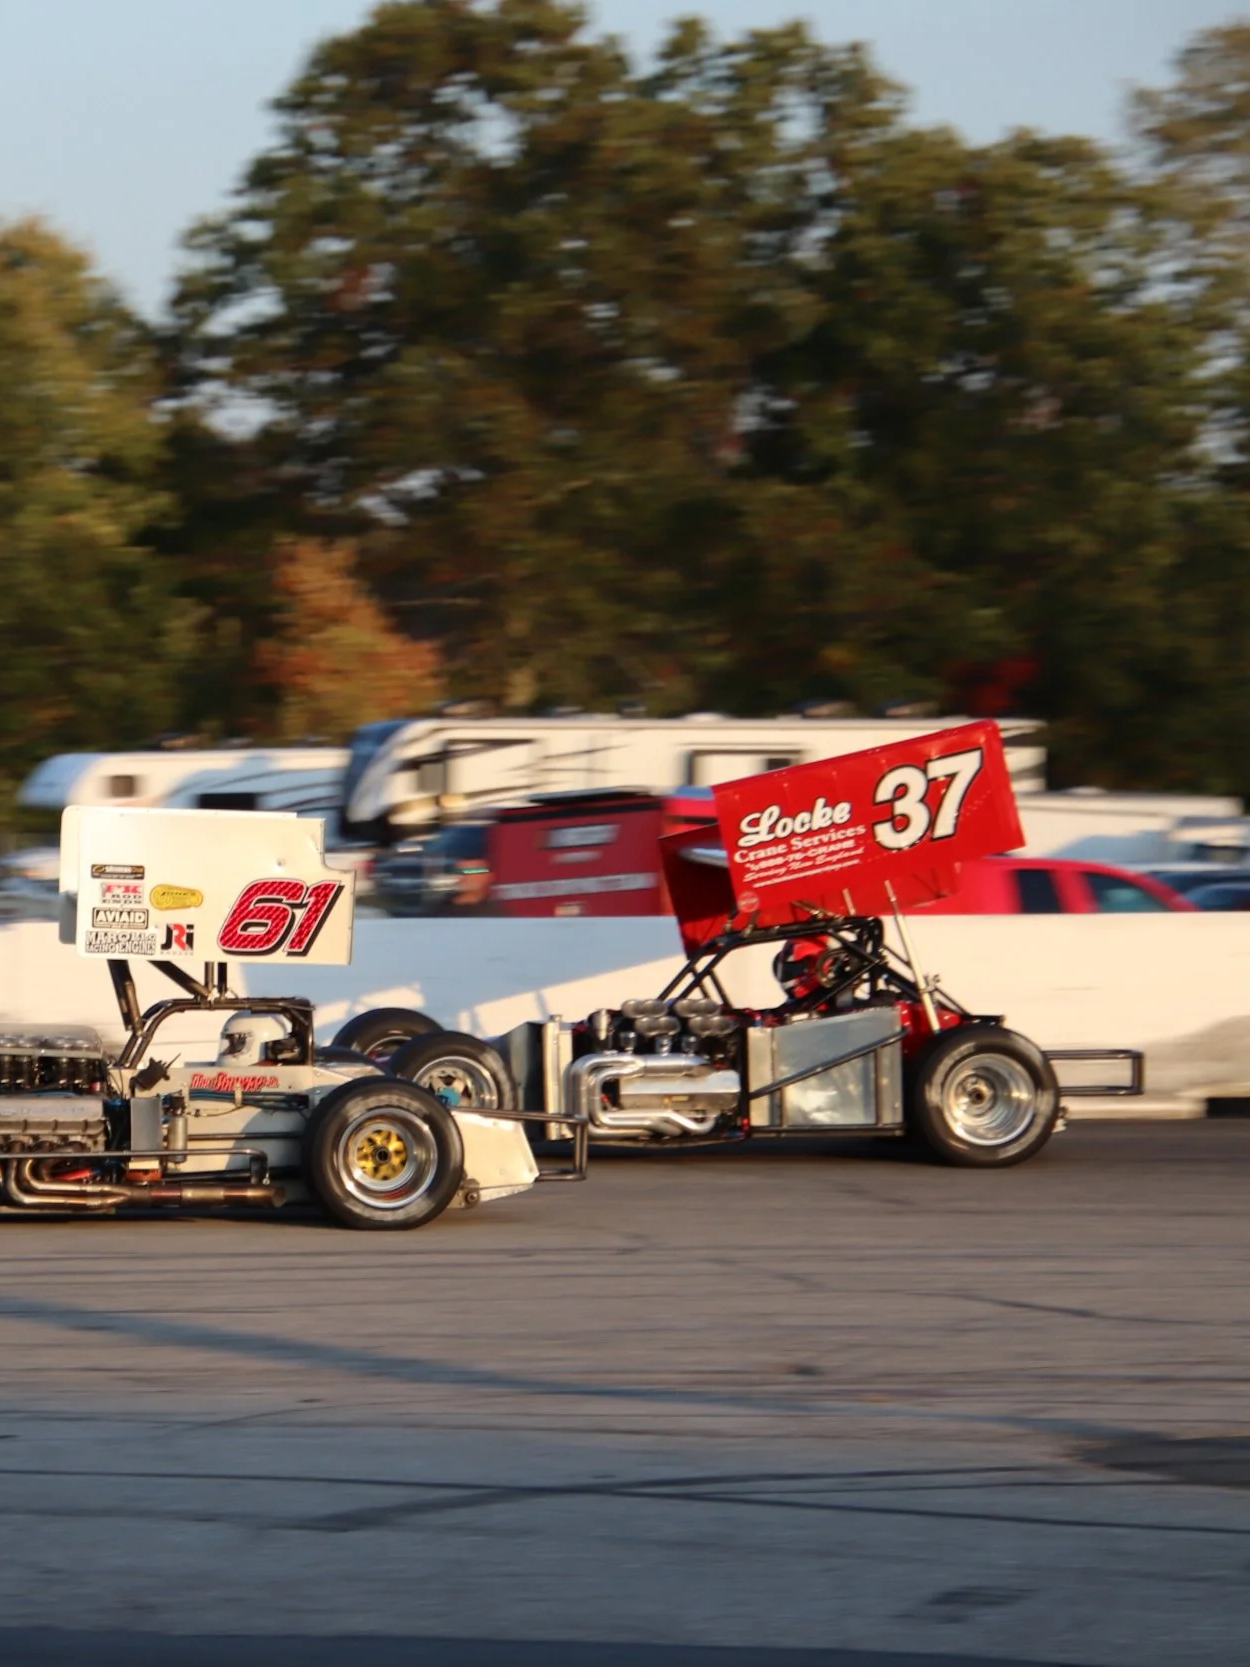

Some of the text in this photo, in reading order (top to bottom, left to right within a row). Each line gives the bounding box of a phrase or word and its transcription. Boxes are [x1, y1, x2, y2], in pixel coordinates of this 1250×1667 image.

[737, 797, 852, 848] Locke
[871, 747, 983, 851] 37
[733, 824, 867, 863] Crane Services
[95, 910, 146, 924] AVIAID
[216, 877, 345, 956] 61
